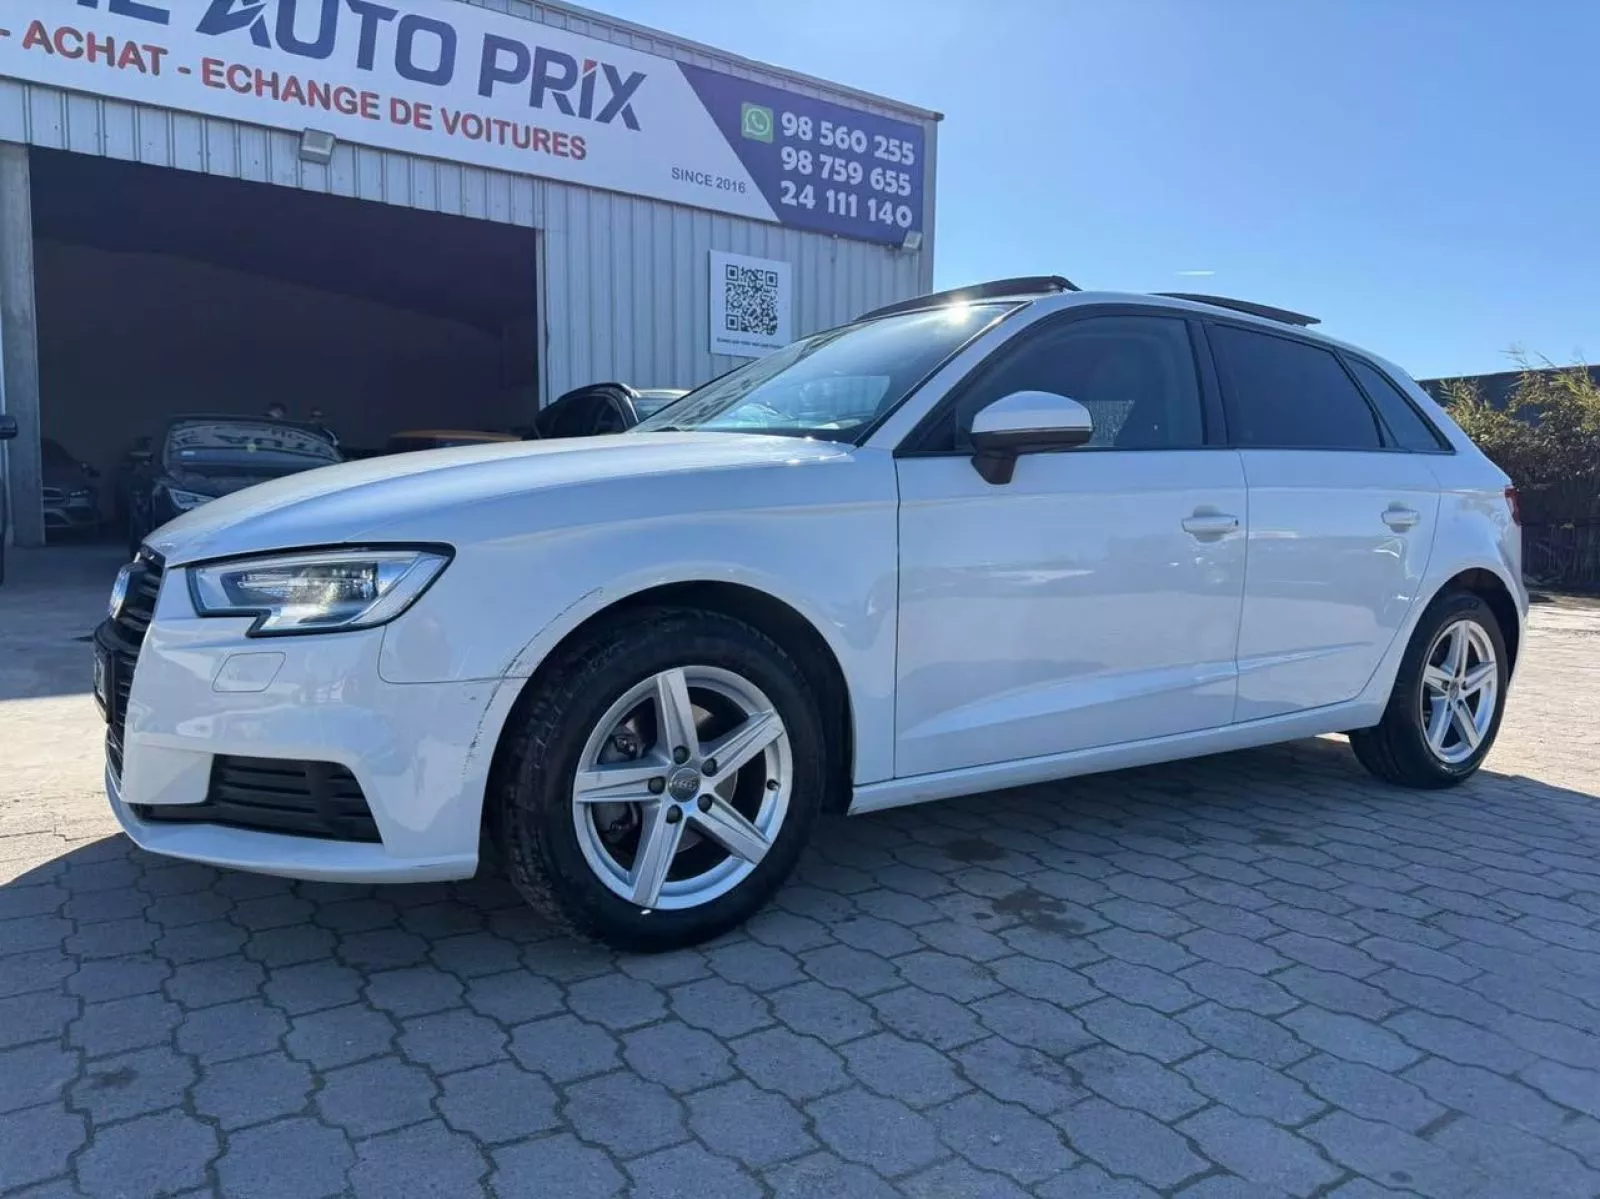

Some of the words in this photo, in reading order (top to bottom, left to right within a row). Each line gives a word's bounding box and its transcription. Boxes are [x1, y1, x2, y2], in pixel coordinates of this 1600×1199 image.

[22, 19, 169, 77] ACHAT
[202, 56, 381, 121] ECHANGE
[389, 97, 433, 131] DE
[440, 107, 587, 161] VOITURES
[195, 0, 457, 87] AUTO
[477, 33, 647, 131] PRIX
[781, 111, 813, 141] 98
[819, 120, 868, 153] 560
[873, 135, 915, 166] 255
[671, 166, 713, 187] SINCE
[715, 176, 746, 194] 2016
[781, 146, 813, 175] 98
[818, 153, 864, 185] 759
[869, 170, 912, 197] 655
[780, 180, 816, 210] 24
[825, 189, 858, 217] 111
[867, 198, 912, 228] 140
